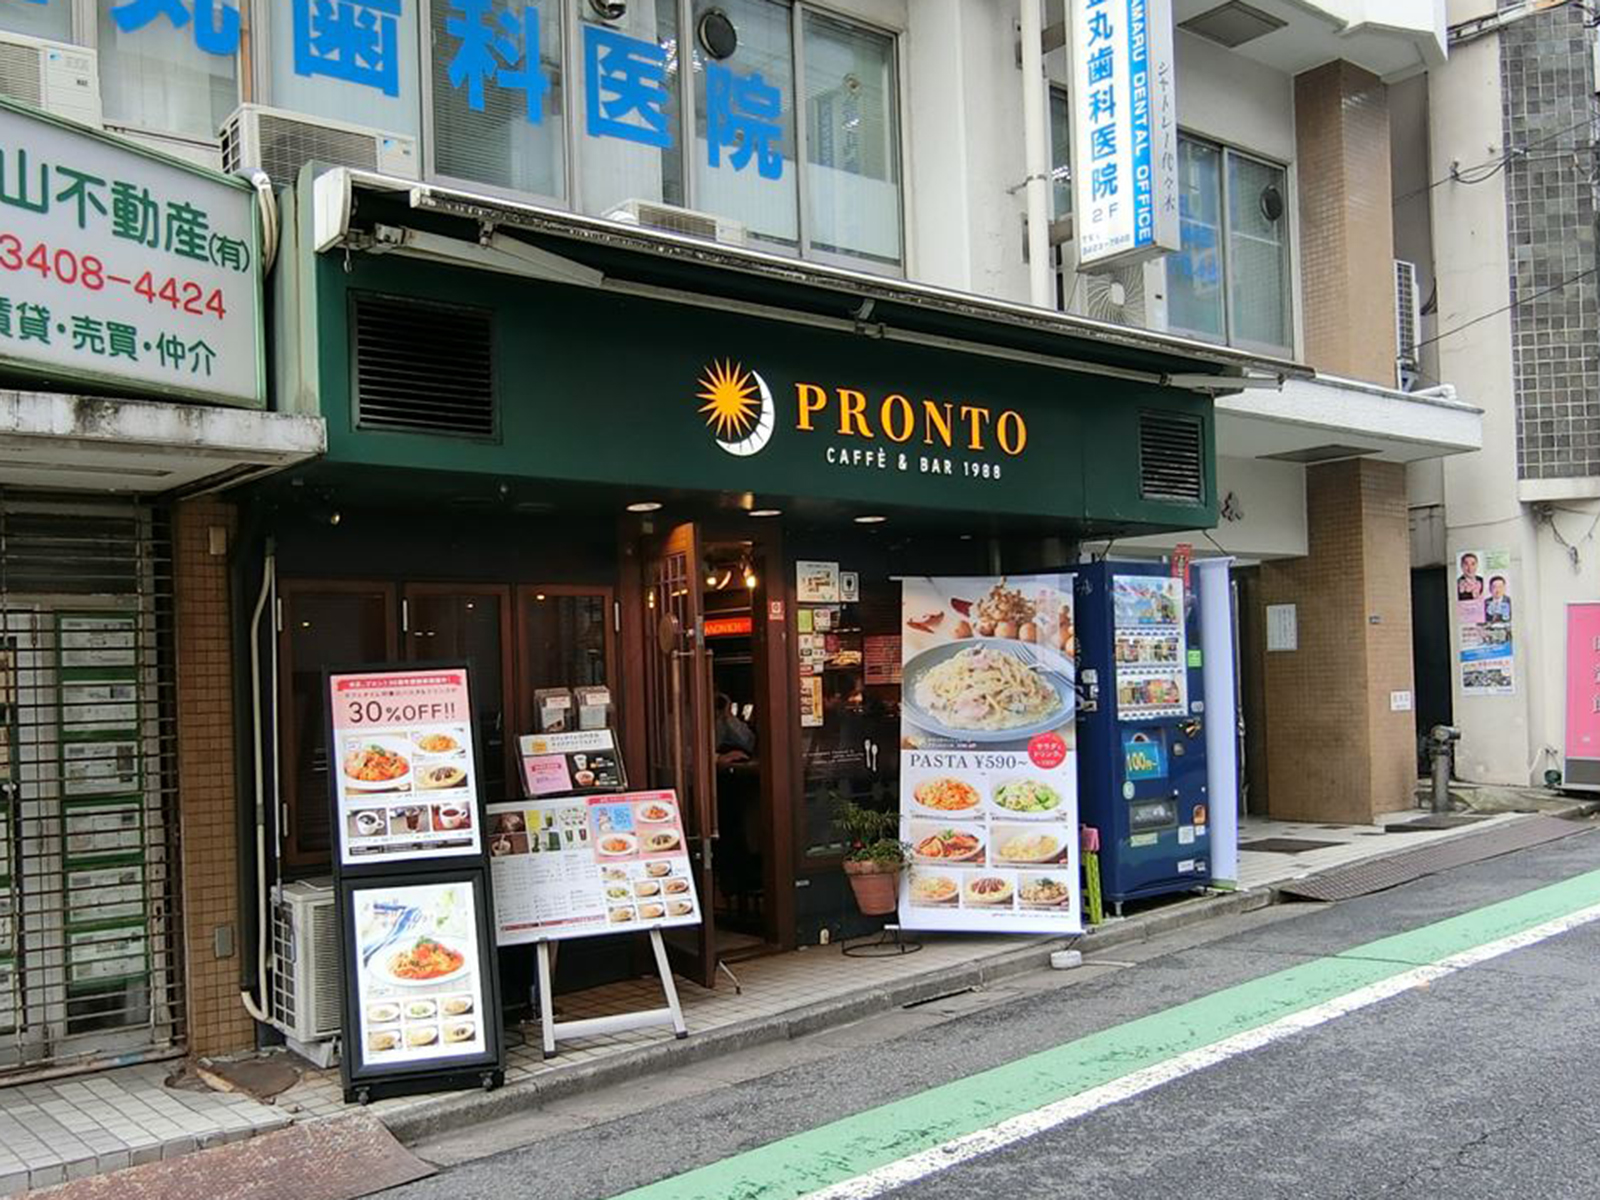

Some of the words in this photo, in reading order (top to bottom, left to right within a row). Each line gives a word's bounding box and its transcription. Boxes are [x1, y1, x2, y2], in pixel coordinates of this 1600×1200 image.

[1132, 71, 1149, 155] DENTAL
[1092, 201, 1119, 223] 2F
[1136, 165, 1151, 241] OFFICE
[0, 234, 226, 320] 3408-4424
[0, 298, 216, 376] 貸・売買・仲介
[795, 382, 1027, 455] PRONTO
[827, 447, 886, 469] CAFFÈ
[898, 453, 909, 471] &
[920, 457, 952, 475] BAR
[963, 461, 1001, 480] 1988
[348, 700, 456, 723] 30%OFF!!
[910, 753, 969, 769] PASTA
